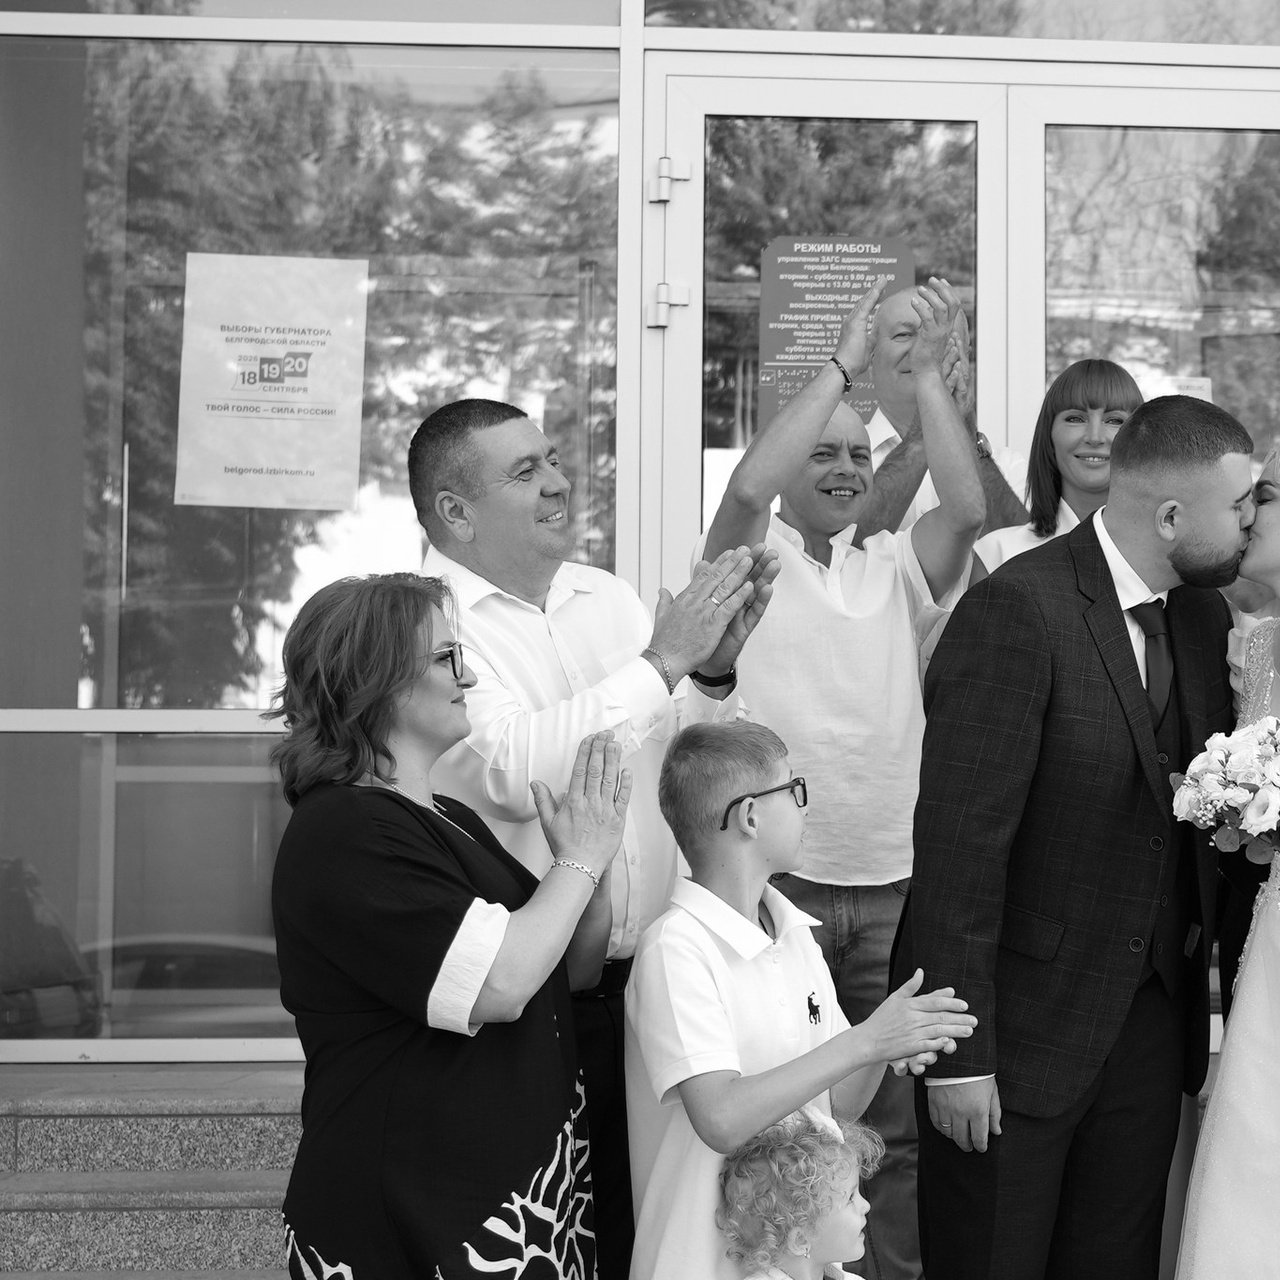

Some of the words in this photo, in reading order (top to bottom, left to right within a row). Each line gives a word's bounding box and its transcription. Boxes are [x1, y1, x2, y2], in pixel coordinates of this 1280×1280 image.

[794, 243, 834, 253] РЕЖИМ
[836, 244, 881, 253] РАБОТЫ
[821, 255, 840, 263] ЗАГС
[814, 273, 843, 281] суббота
[811, 313, 842, 321] ПРИЁМА
[220, 324, 262, 334] ВЫБОРЫ
[264, 326, 332, 336] ГУБЕРНАТОРА
[225, 336, 287, 346] БЕЛГОРОДСКОЙ
[289, 339, 326, 347] ОБЛАСТИ
[239, 370, 257, 385] 18
[261, 363, 281, 379] 19
[284, 357, 307, 373] 20
[262, 385, 308, 394] СЕНТЯБРЯ
[205, 403, 230, 412] ТВОЙ
[232, 404, 261, 413] ГОЛОС
[297, 408, 336, 416] РОССИИ!
[224, 465, 315, 477] belgorod.izbirkom.ru
